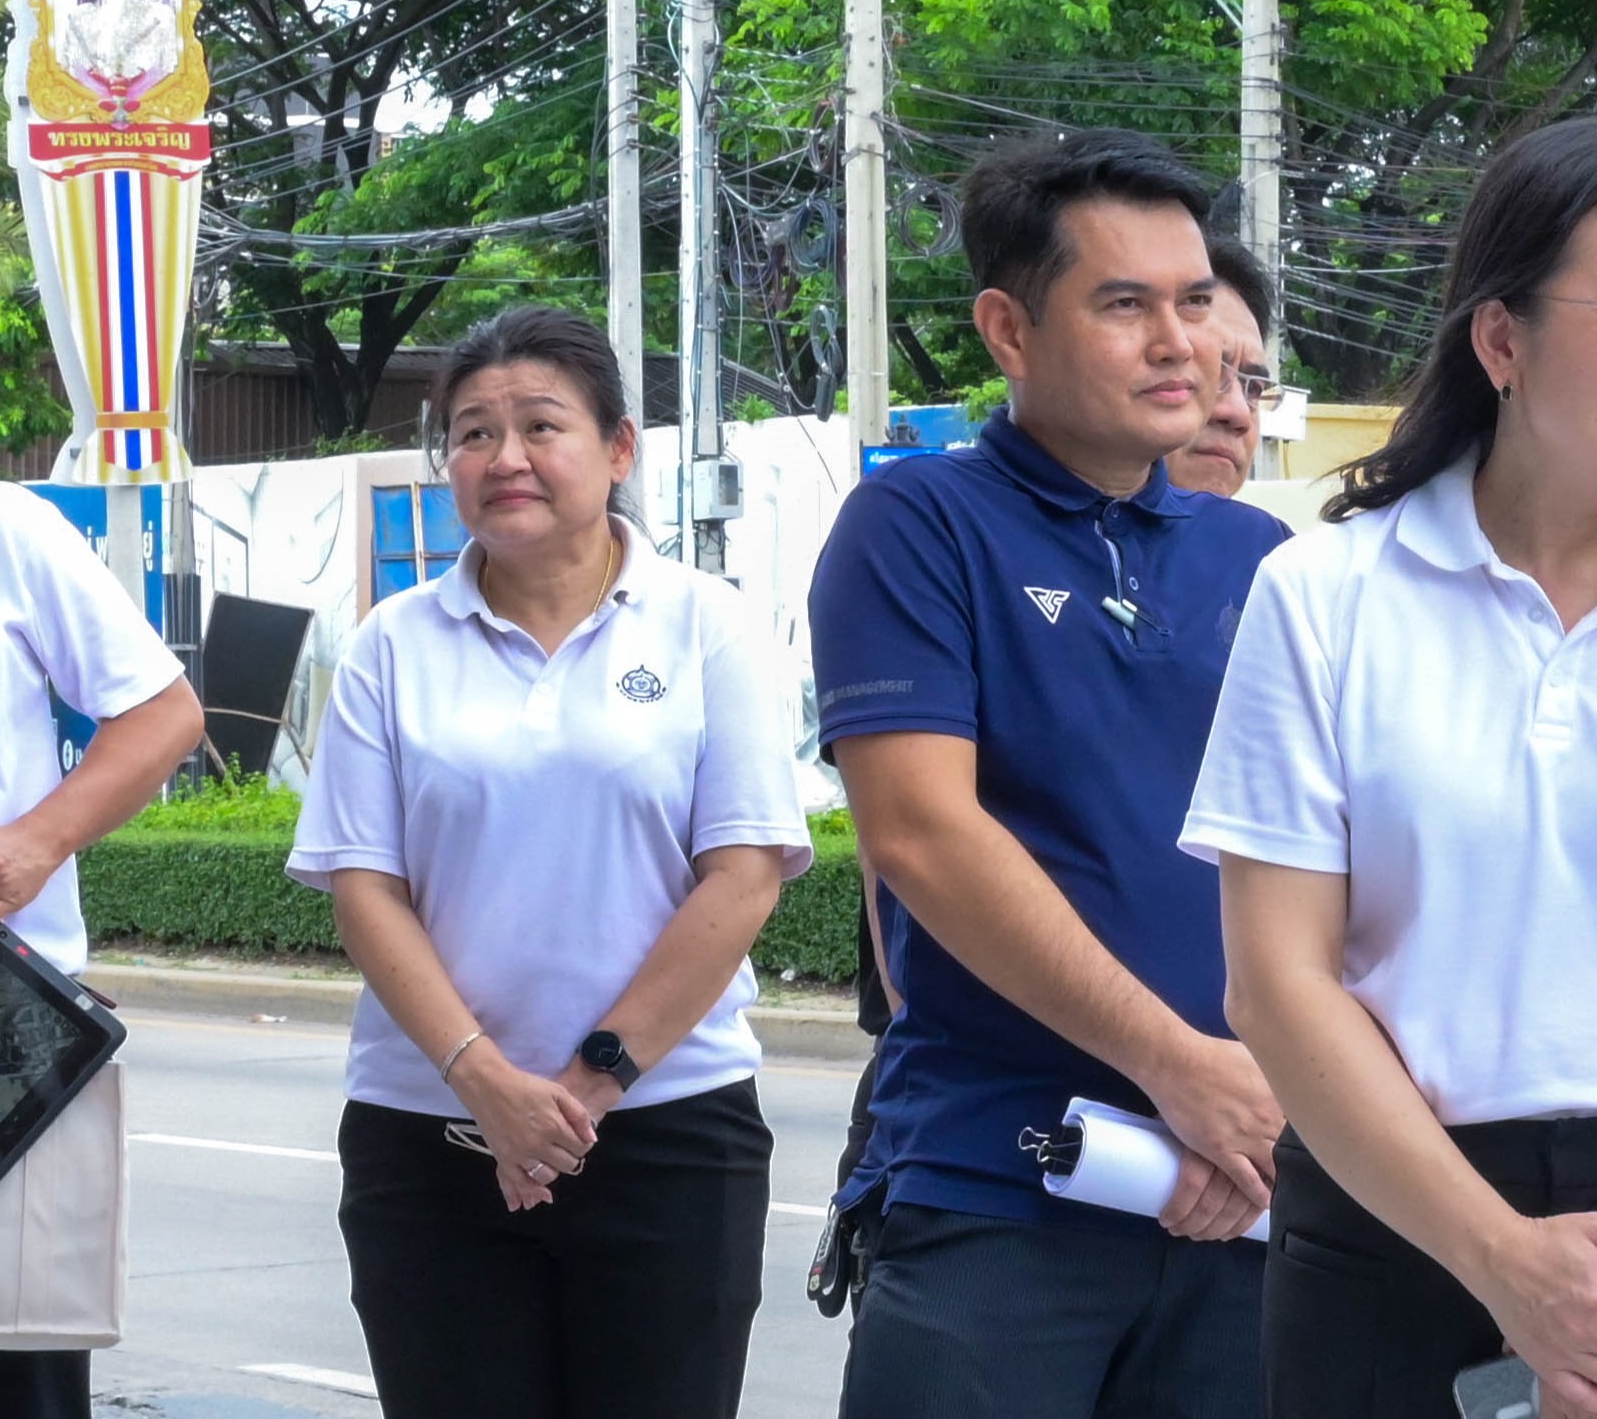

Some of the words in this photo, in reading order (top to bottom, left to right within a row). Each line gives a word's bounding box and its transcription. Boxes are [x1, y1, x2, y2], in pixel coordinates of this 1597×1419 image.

[48, 126, 191, 150] ทรงพระเจริญ
